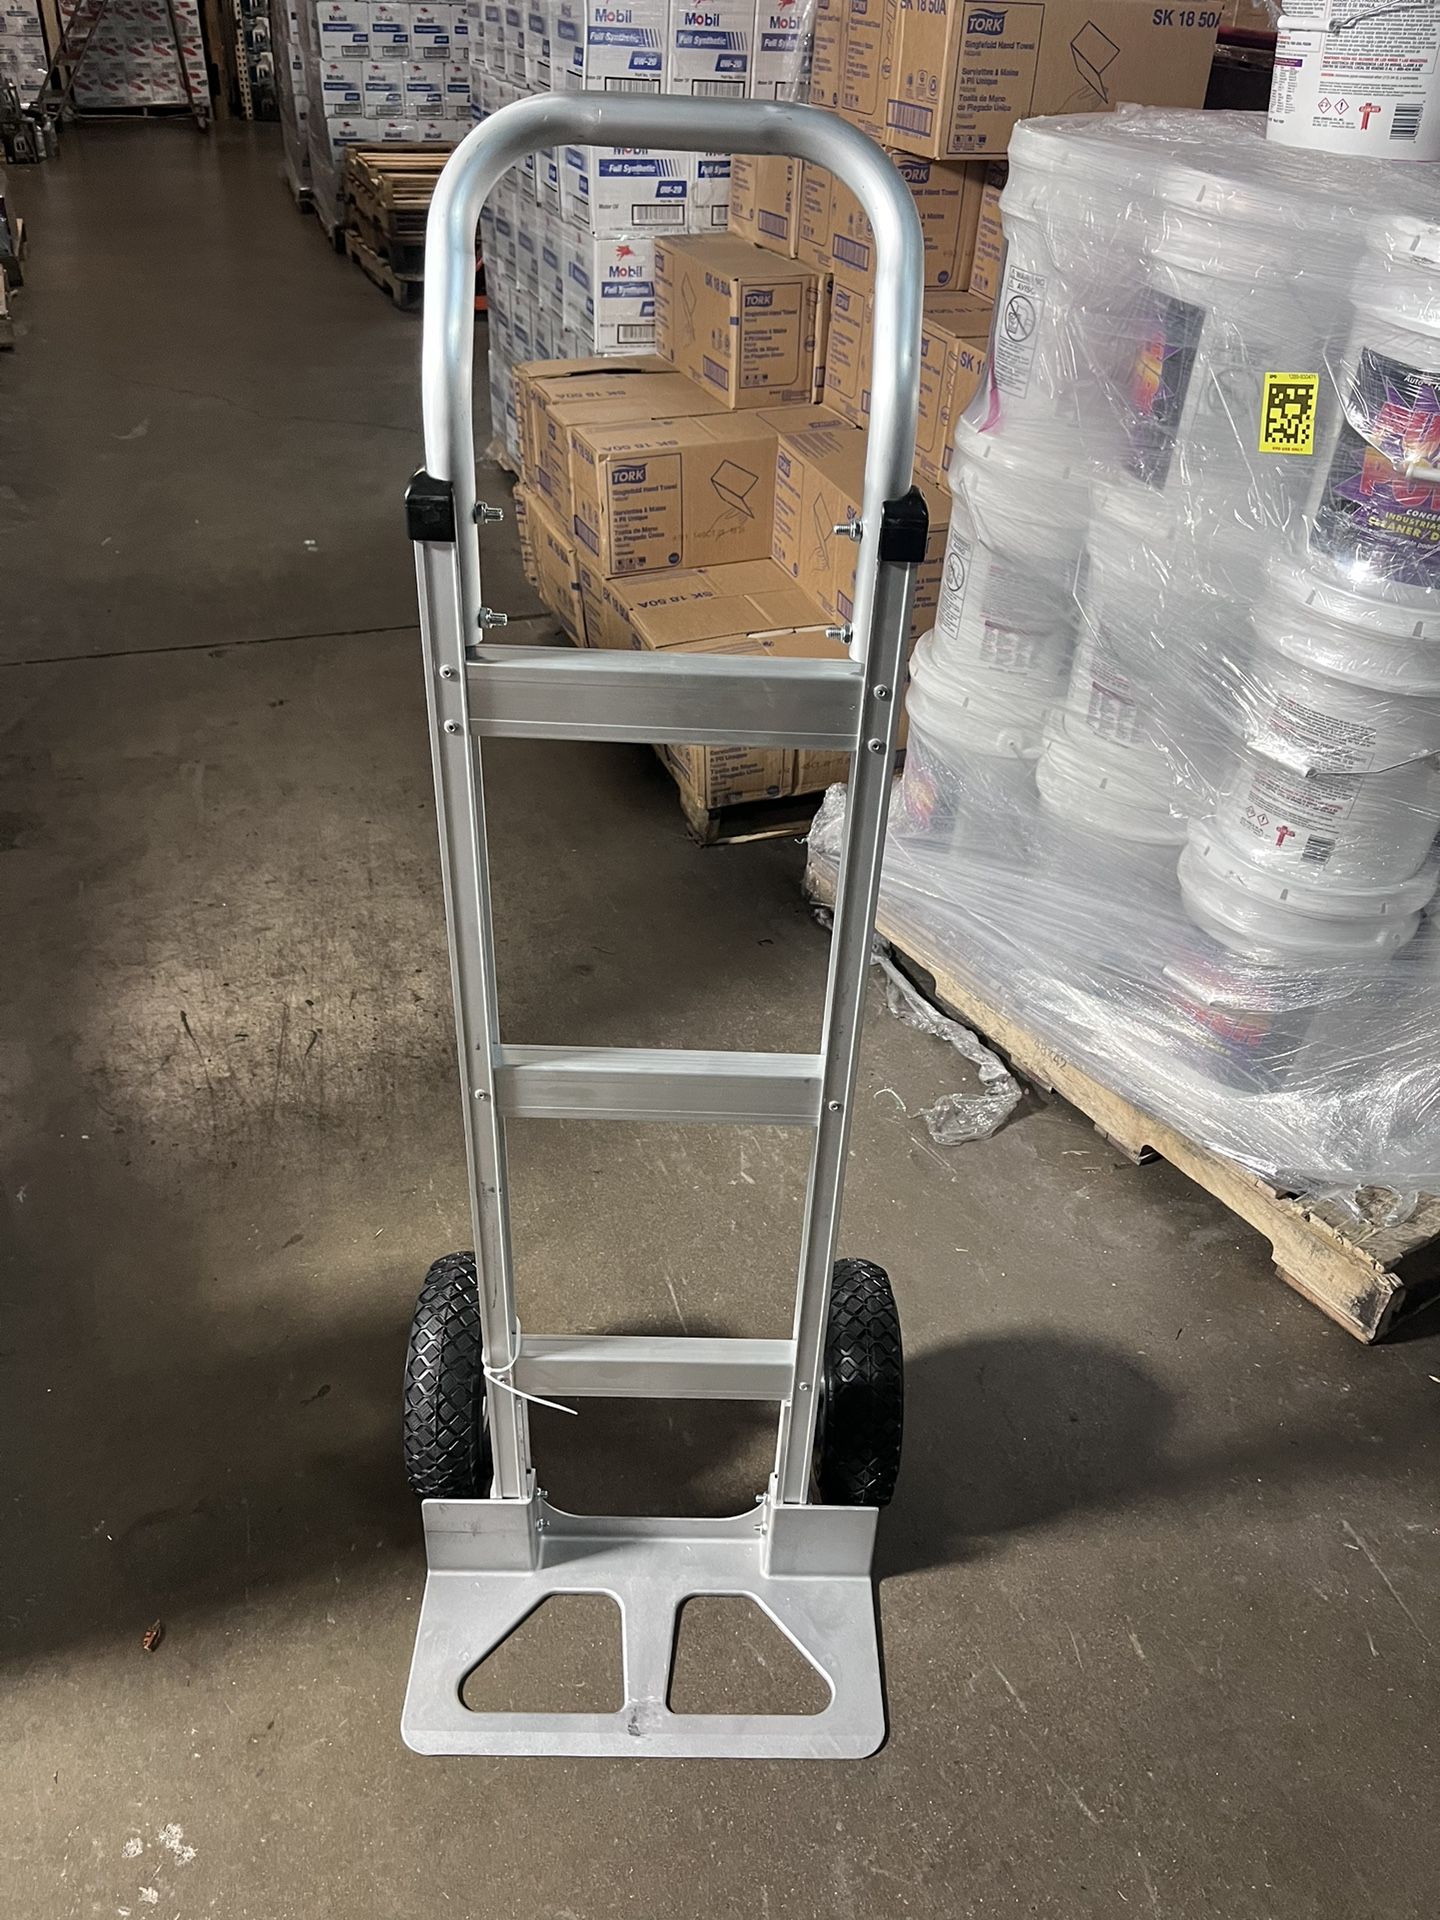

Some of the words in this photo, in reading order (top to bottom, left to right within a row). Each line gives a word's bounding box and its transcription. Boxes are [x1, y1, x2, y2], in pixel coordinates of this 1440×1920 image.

[594, 8, 632, 24] Mobil
[684, 12, 720, 27] Mobil
[1152, 9, 1175, 26] SK
[1179, 11, 1196, 27] 18
[968, 17, 1003, 33] TORK
[679, 34, 693, 46] Full
[693, 34, 727, 48] Synthetic
[609, 163, 622, 174] Full
[623, 163, 656, 175] Synthetic
[899, 168, 928, 181] ORK
[608, 265, 643, 278] Mobil
[745, 294, 772, 306] TORK
[960, 351, 974, 372] SK
[613, 471, 644, 483] TORK
[670, 595, 688, 603] 18
[691, 591, 713, 599] SK
[637, 598, 667, 609] 50A
